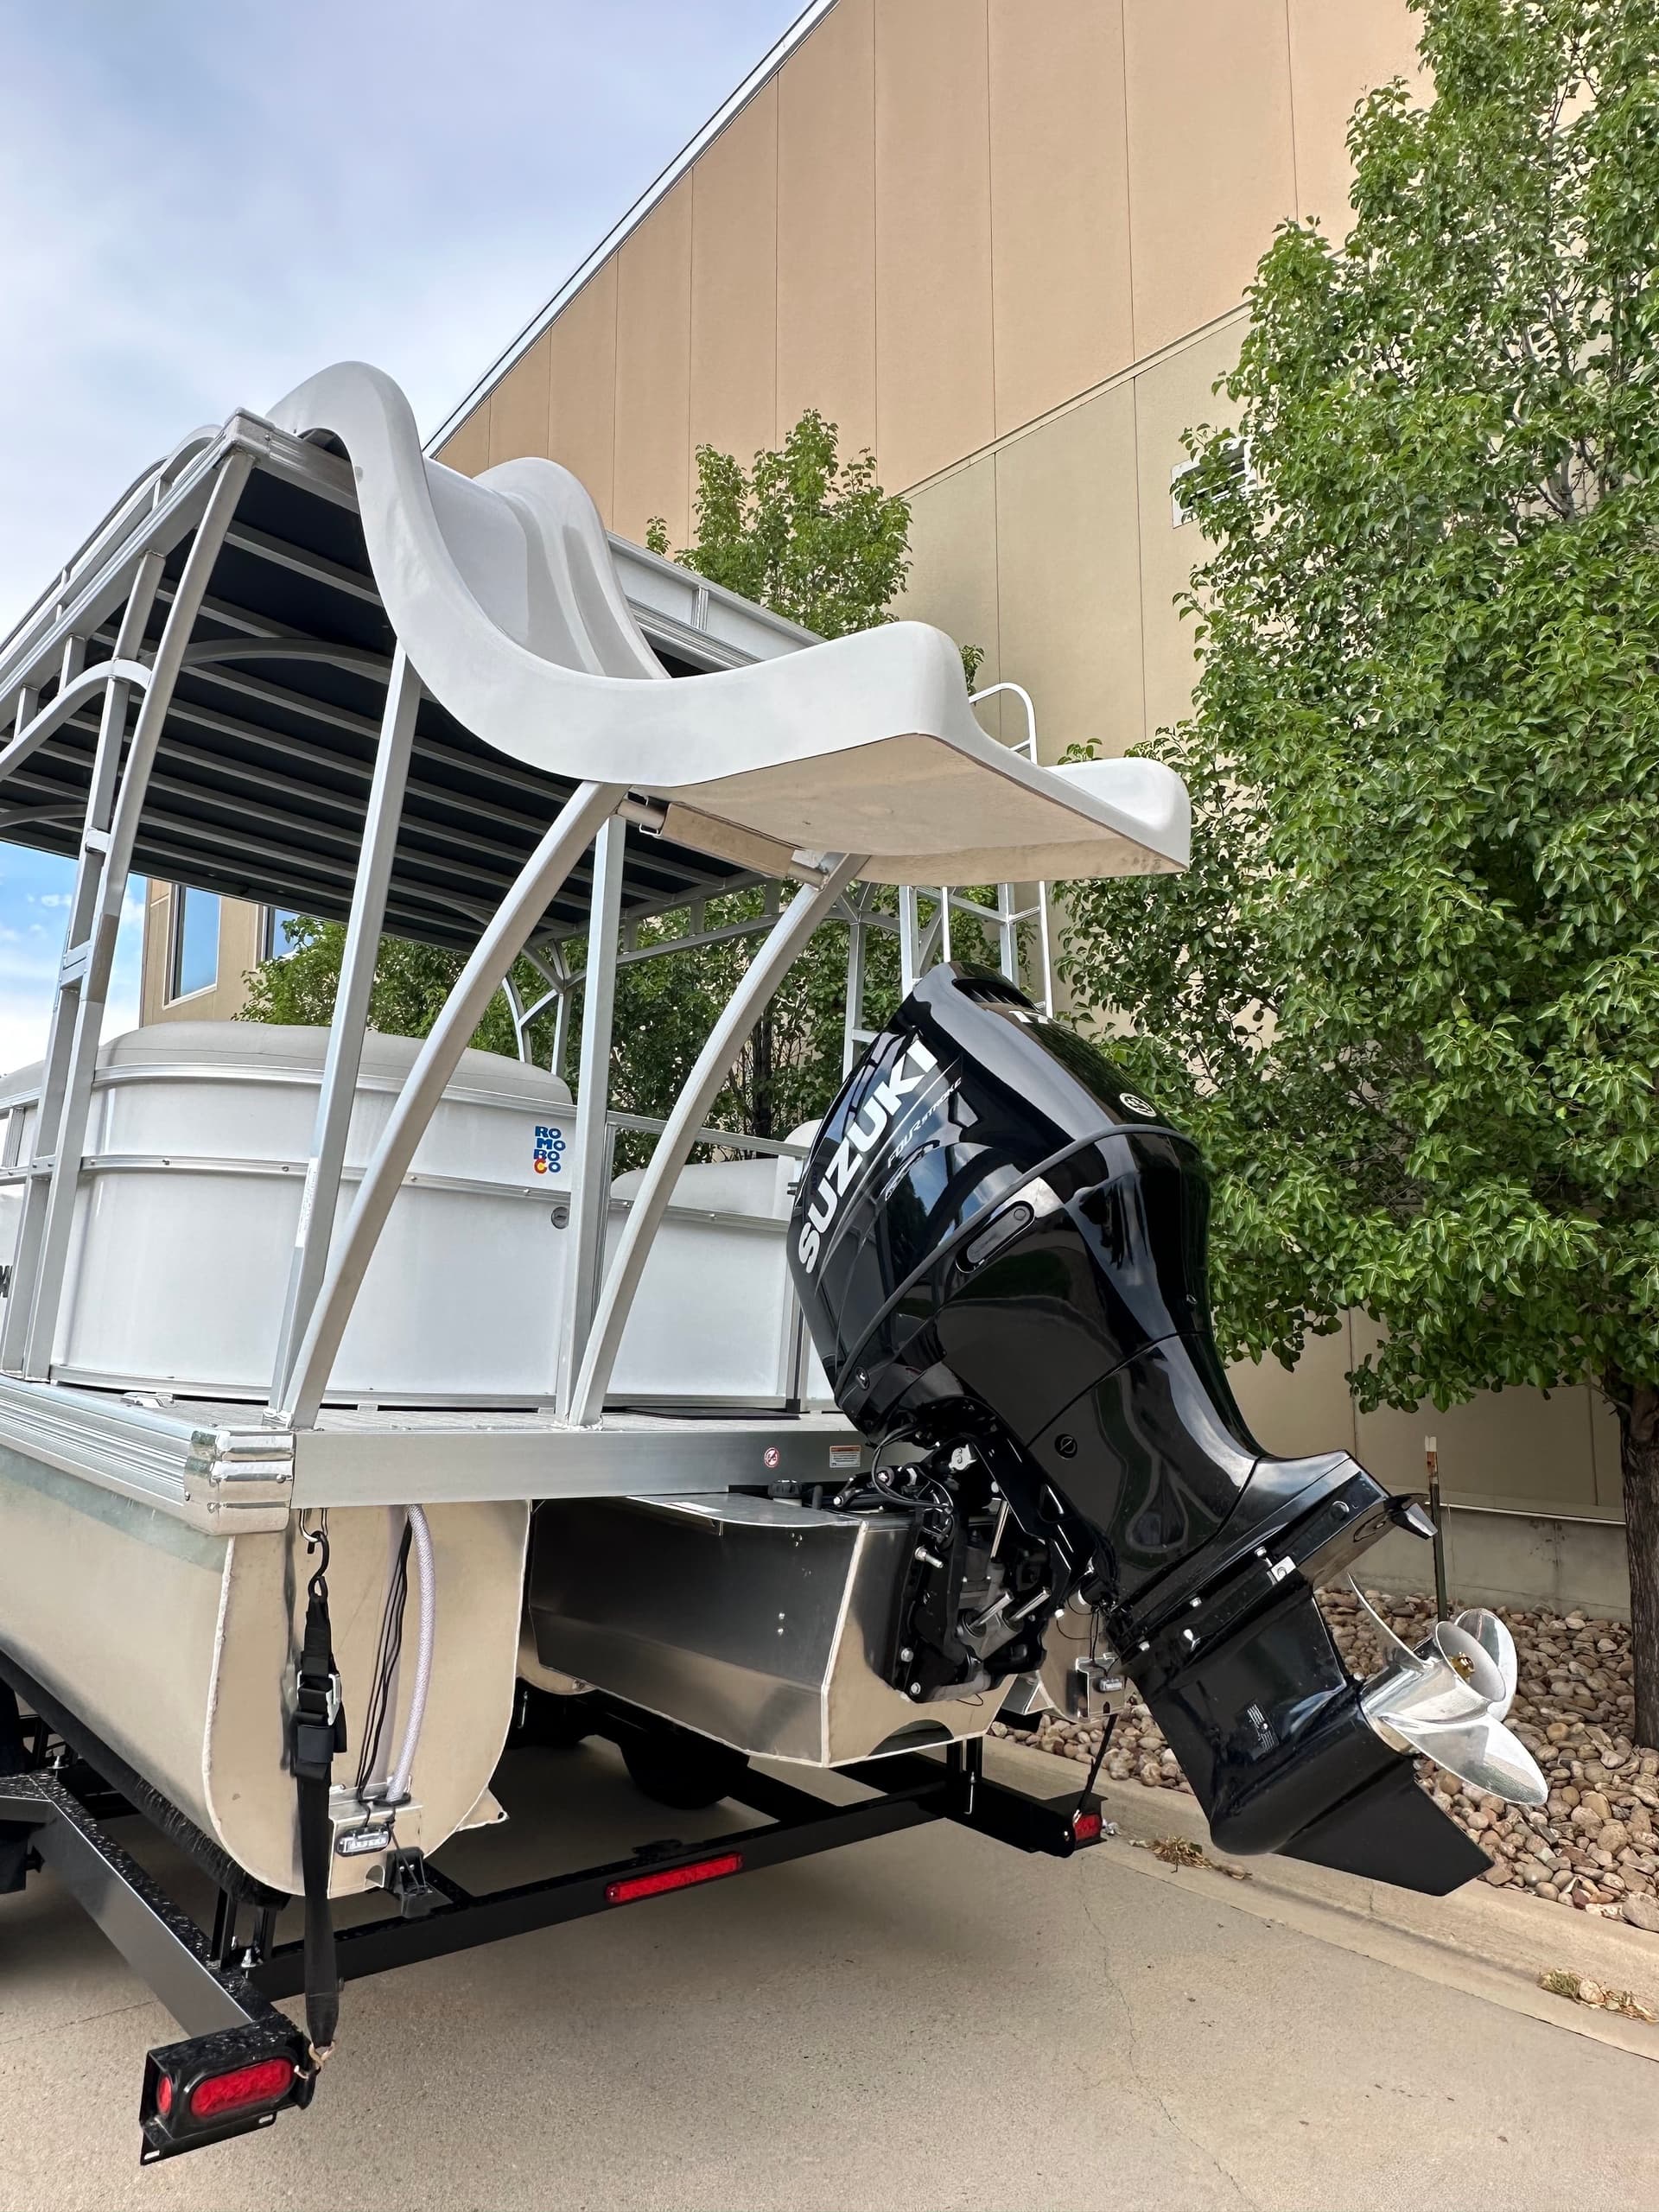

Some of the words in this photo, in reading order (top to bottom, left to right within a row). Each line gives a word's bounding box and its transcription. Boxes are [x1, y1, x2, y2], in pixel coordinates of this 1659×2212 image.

[534, 1125, 562, 1140] RO
[536, 1137, 566, 1152] MO
[798, 1039, 938, 1274] SUZUKI
[534, 1159, 562, 1174] CO
